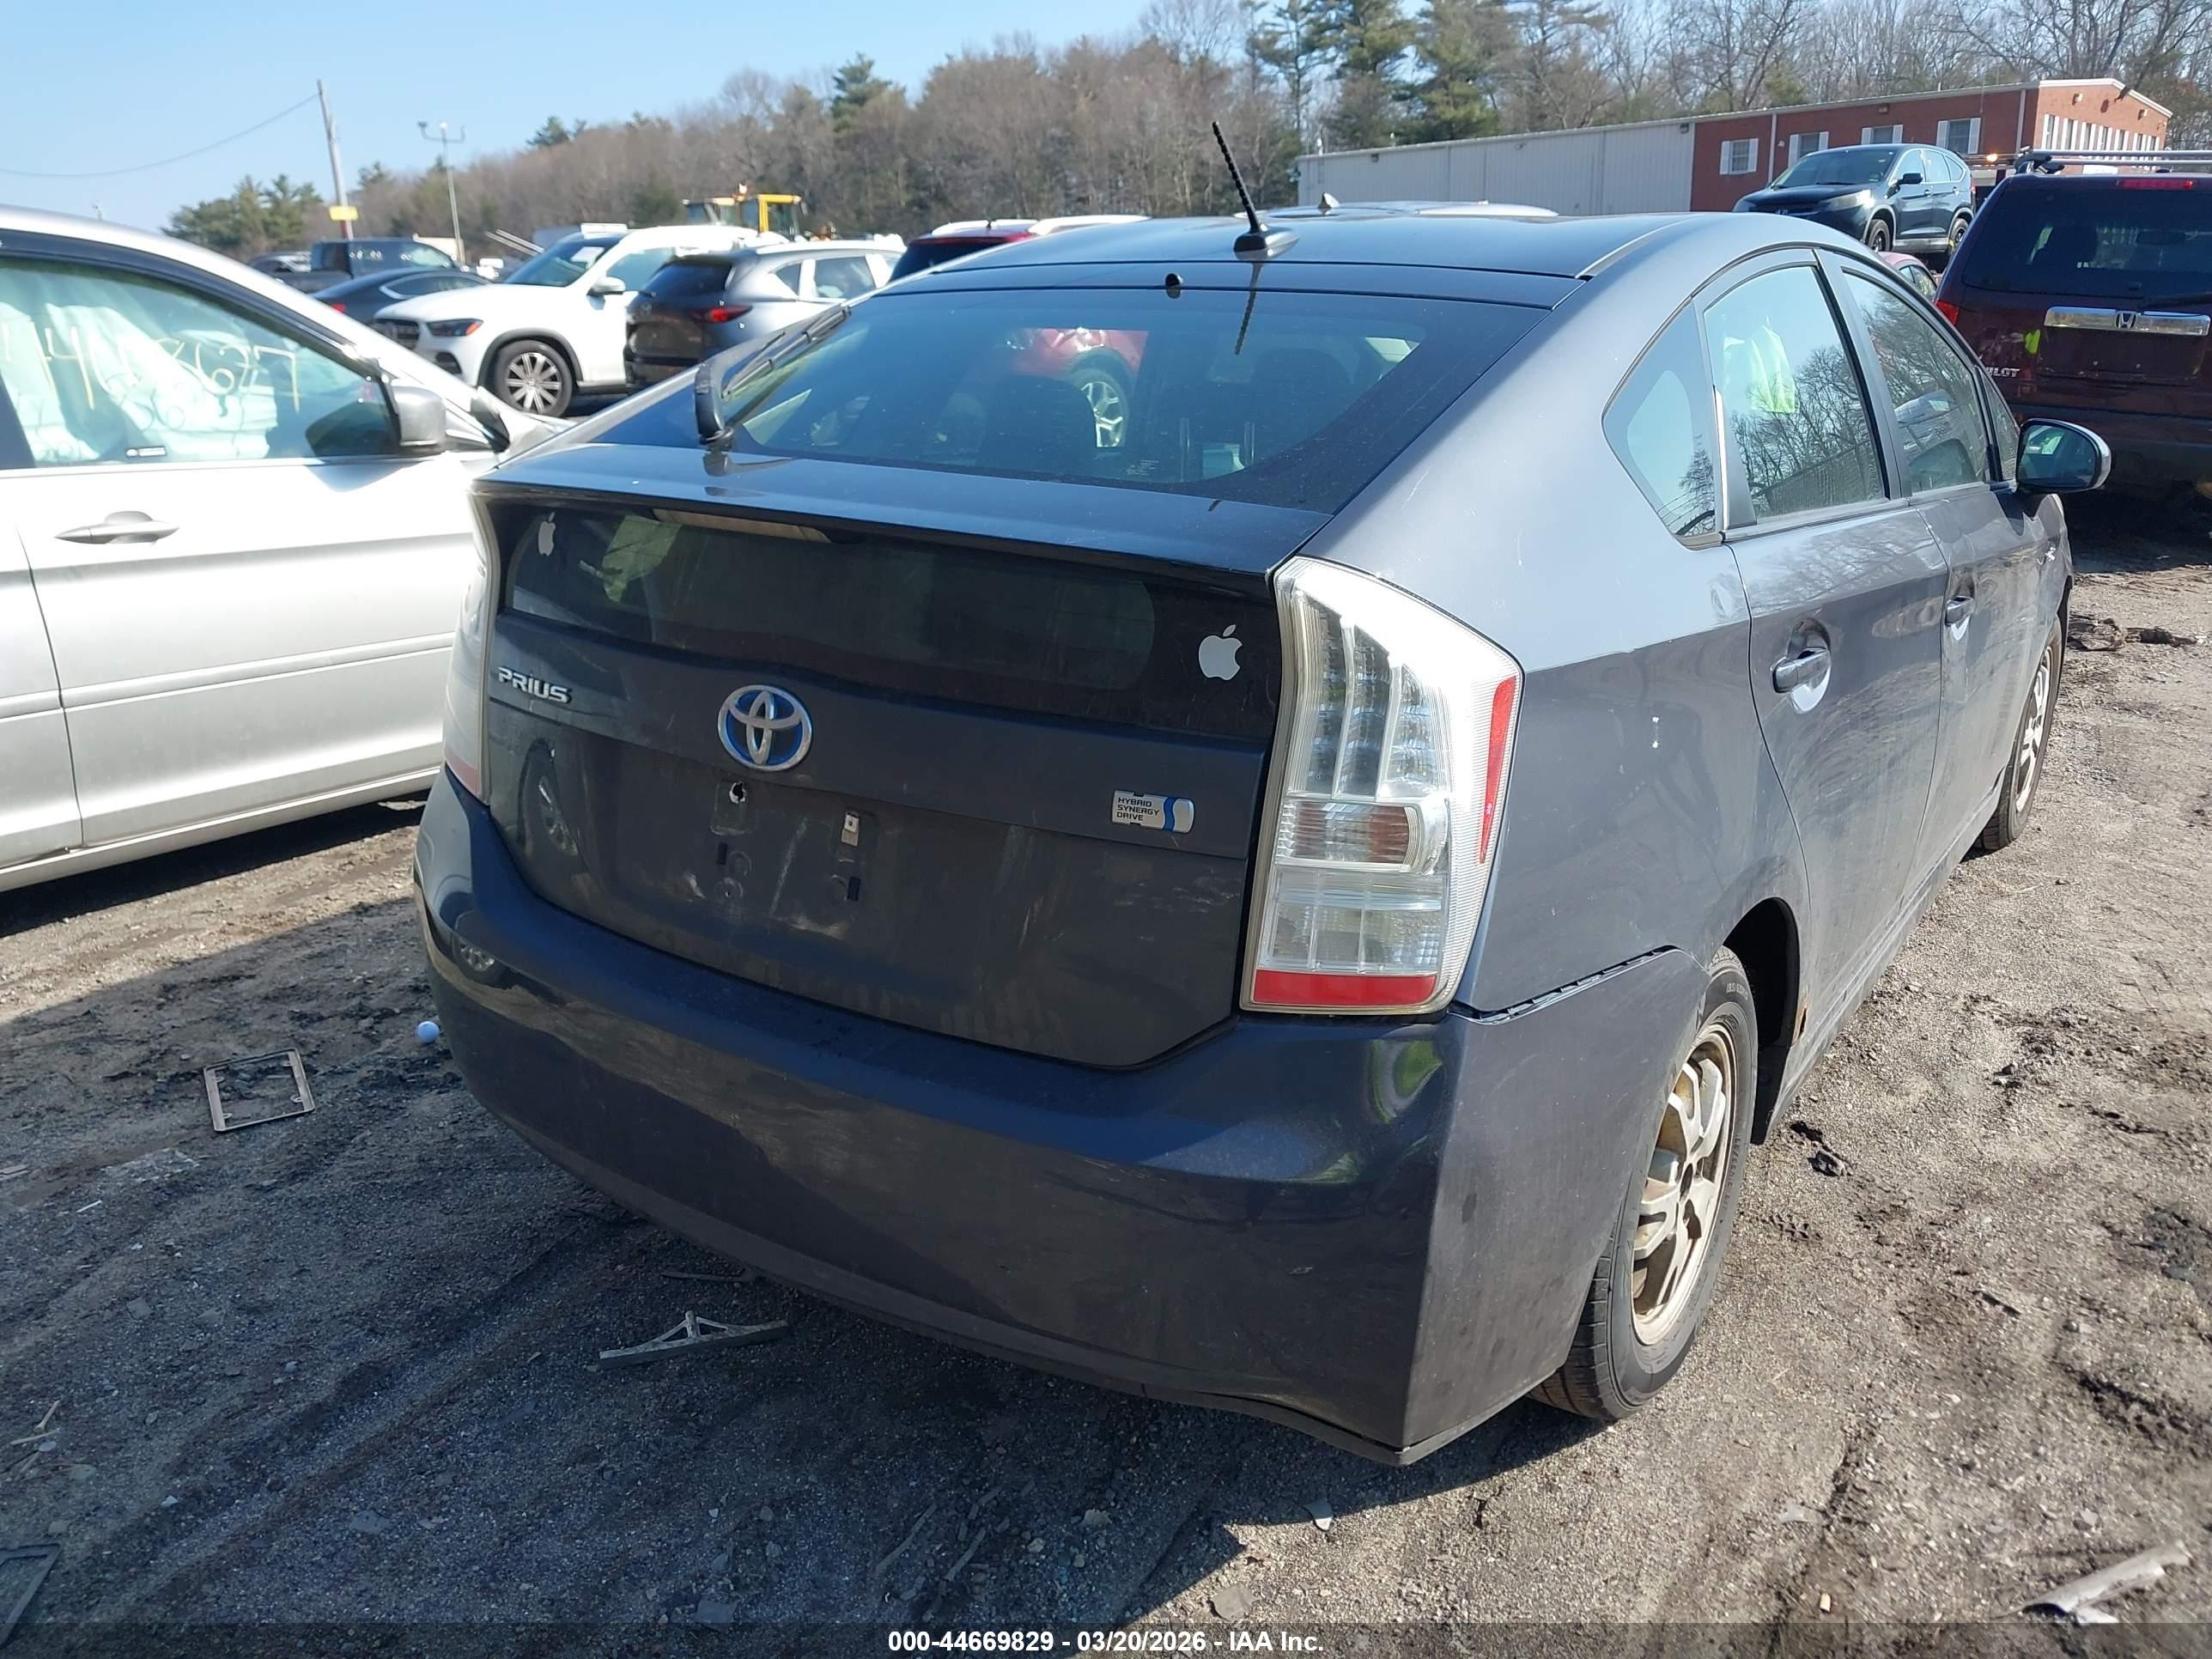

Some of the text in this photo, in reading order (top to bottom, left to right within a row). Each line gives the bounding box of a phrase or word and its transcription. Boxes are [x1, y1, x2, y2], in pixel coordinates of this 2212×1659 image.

[1117, 797, 1152, 807] HYBRID
[1116, 804, 1160, 816] SYNERGY
[1116, 811, 1144, 821] DRIVE
